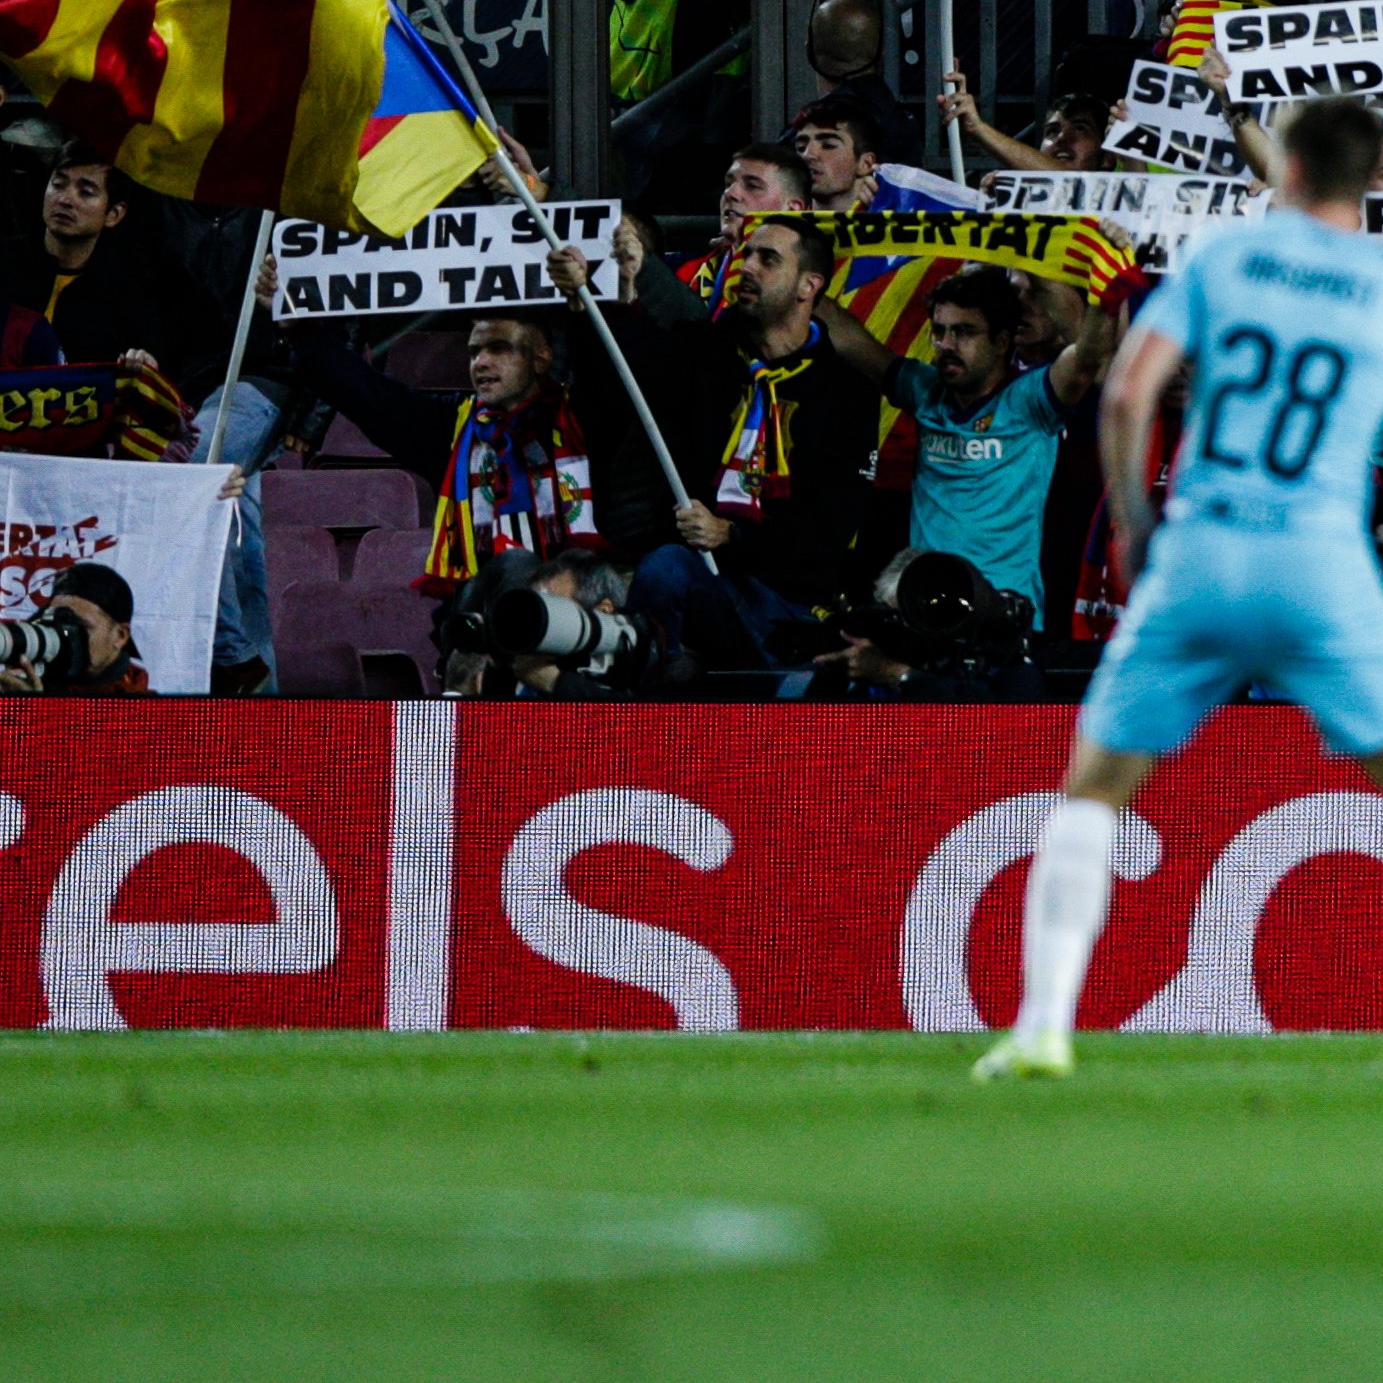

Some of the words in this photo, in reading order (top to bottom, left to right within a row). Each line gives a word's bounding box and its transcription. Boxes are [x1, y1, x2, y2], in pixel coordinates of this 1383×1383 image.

[1241, 60, 1383, 98] AND
[1114, 123, 1248, 176] AND
[1172, 180, 1250, 216] SIT
[511, 205, 611, 244] SIT
[280, 270, 423, 316] AND
[1201, 325, 1348, 482] 28
